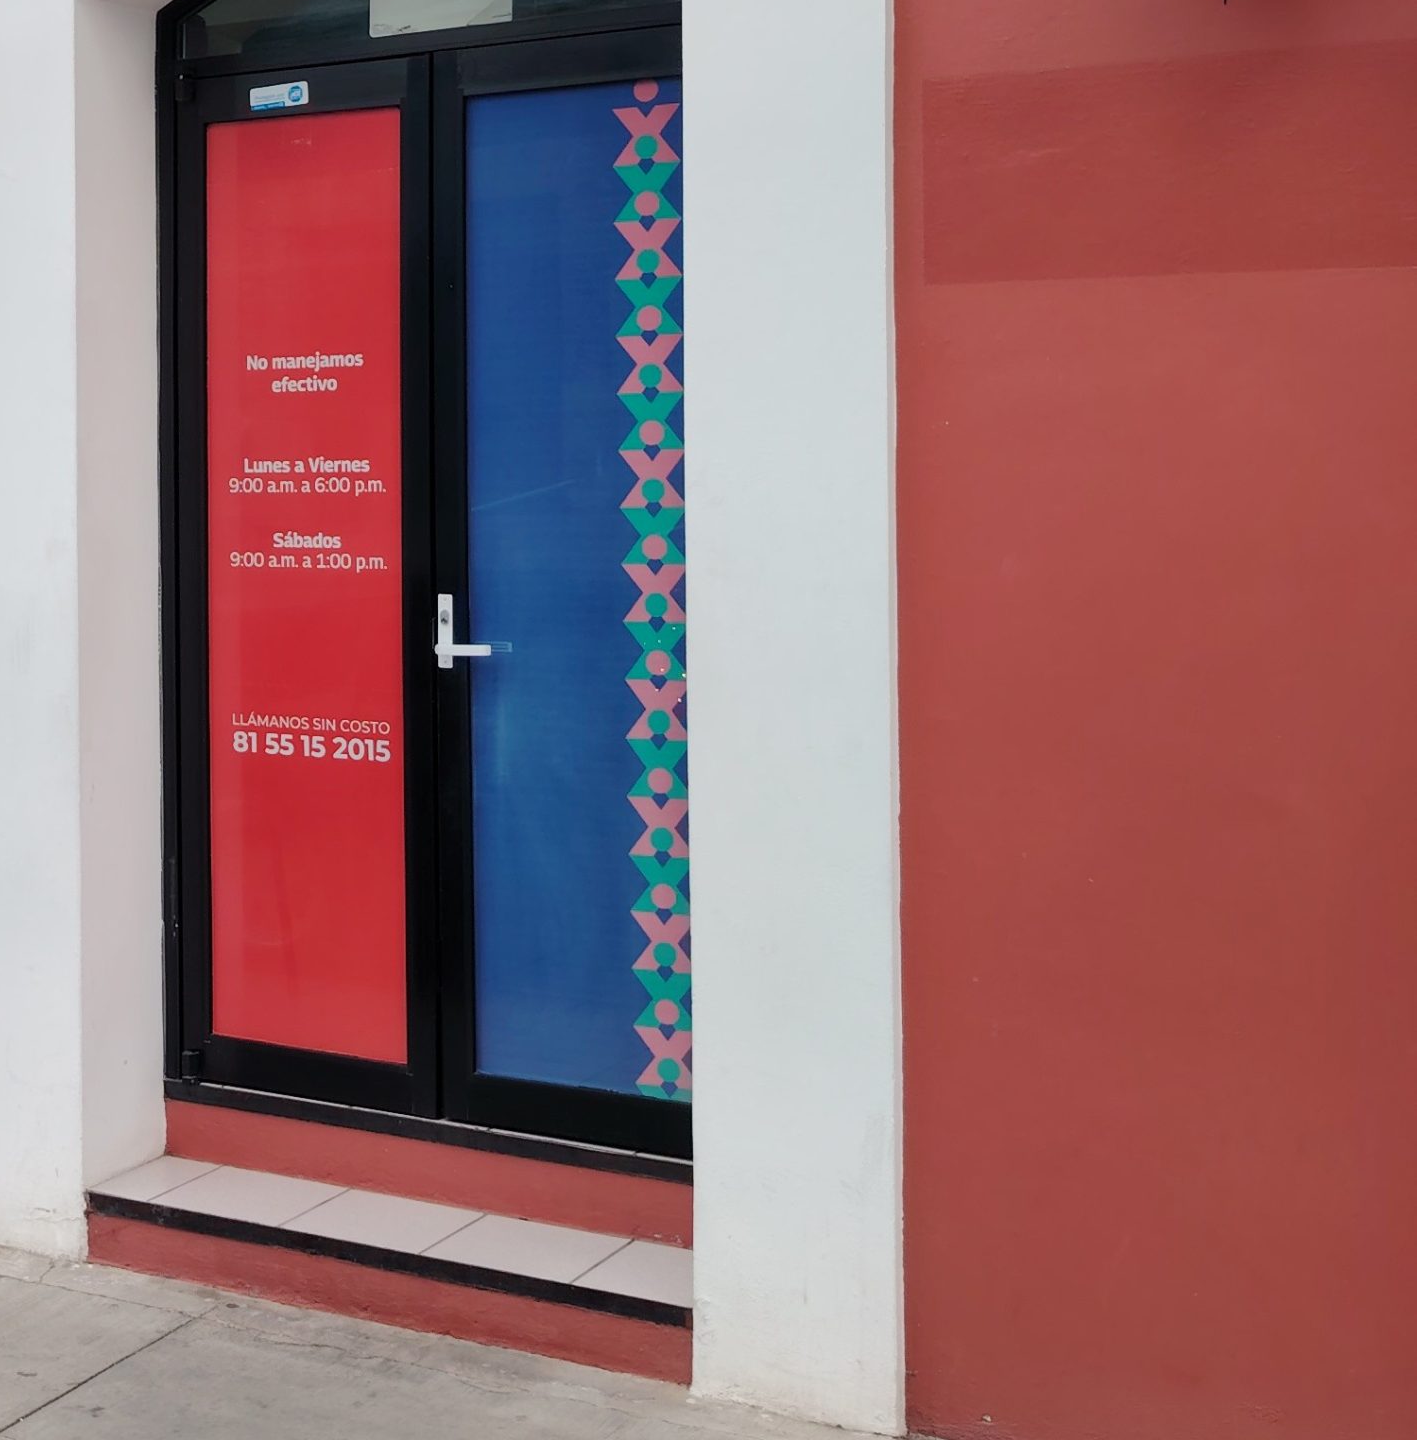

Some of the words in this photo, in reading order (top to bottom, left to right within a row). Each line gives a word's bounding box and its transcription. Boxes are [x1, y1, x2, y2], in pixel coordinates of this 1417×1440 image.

[246, 355, 268, 371] No
[272, 352, 364, 372] manejamos
[271, 375, 338, 393] efectivo
[244, 458, 291, 474] Lunes
[294, 461, 305, 473] a
[308, 457, 371, 473] Viernes
[228, 477, 264, 494] 9:00
[267, 480, 298, 493] a.m.
[301, 480, 311, 493] a
[314, 477, 351, 493] 6:00
[354, 479, 387, 497] p.m.
[273, 530, 342, 549] Sábados
[229, 551, 265, 568] 9:00
[268, 554, 299, 569] a.m.
[302, 555, 313, 569] a
[316, 553, 352, 570] 1:00
[356, 556, 388, 574] p.m.
[232, 711, 310, 731] LLÁMANOS
[312, 717, 336, 732] SIN
[340, 719, 391, 735] COSTO
[233, 731, 257, 753] 81
[264, 733, 295, 756] 55
[300, 734, 327, 758] 15
[332, 736, 392, 763] 2015
